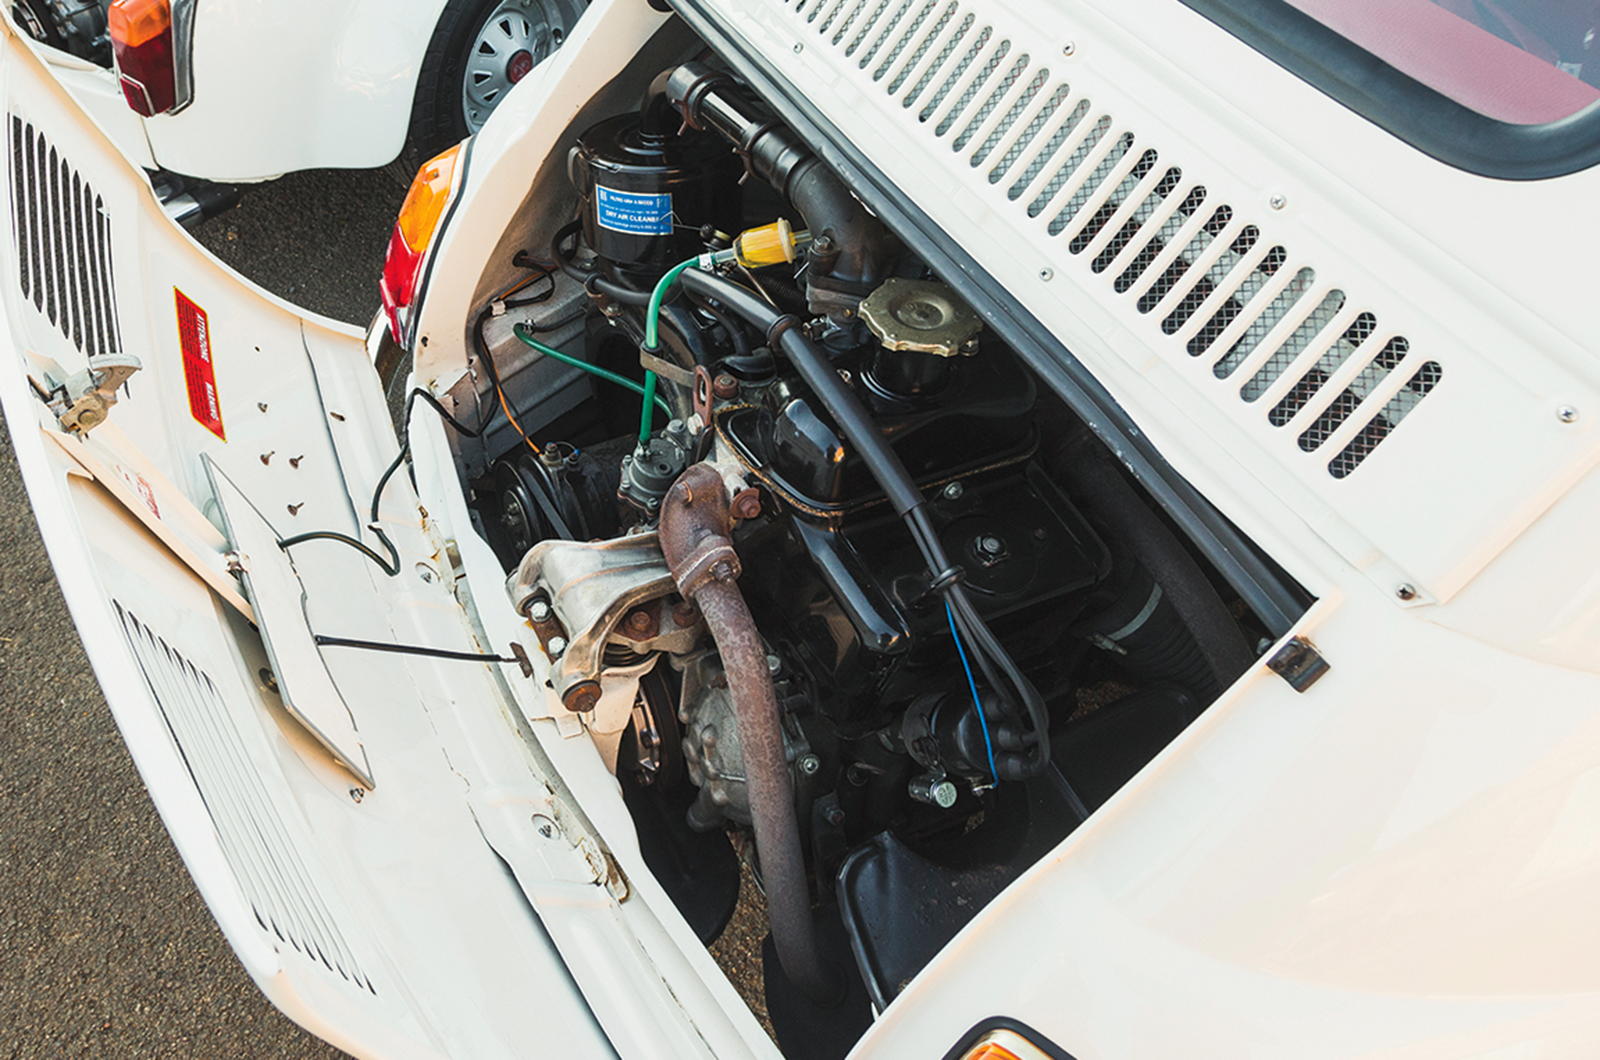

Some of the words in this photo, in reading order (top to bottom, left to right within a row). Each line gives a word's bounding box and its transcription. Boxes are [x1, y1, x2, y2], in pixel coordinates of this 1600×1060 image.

[605, 209, 618, 218] DRY
[617, 213, 629, 221] AIR
[196, 312, 210, 363] ATTENZIONE
[205, 381, 219, 421] WARNING
